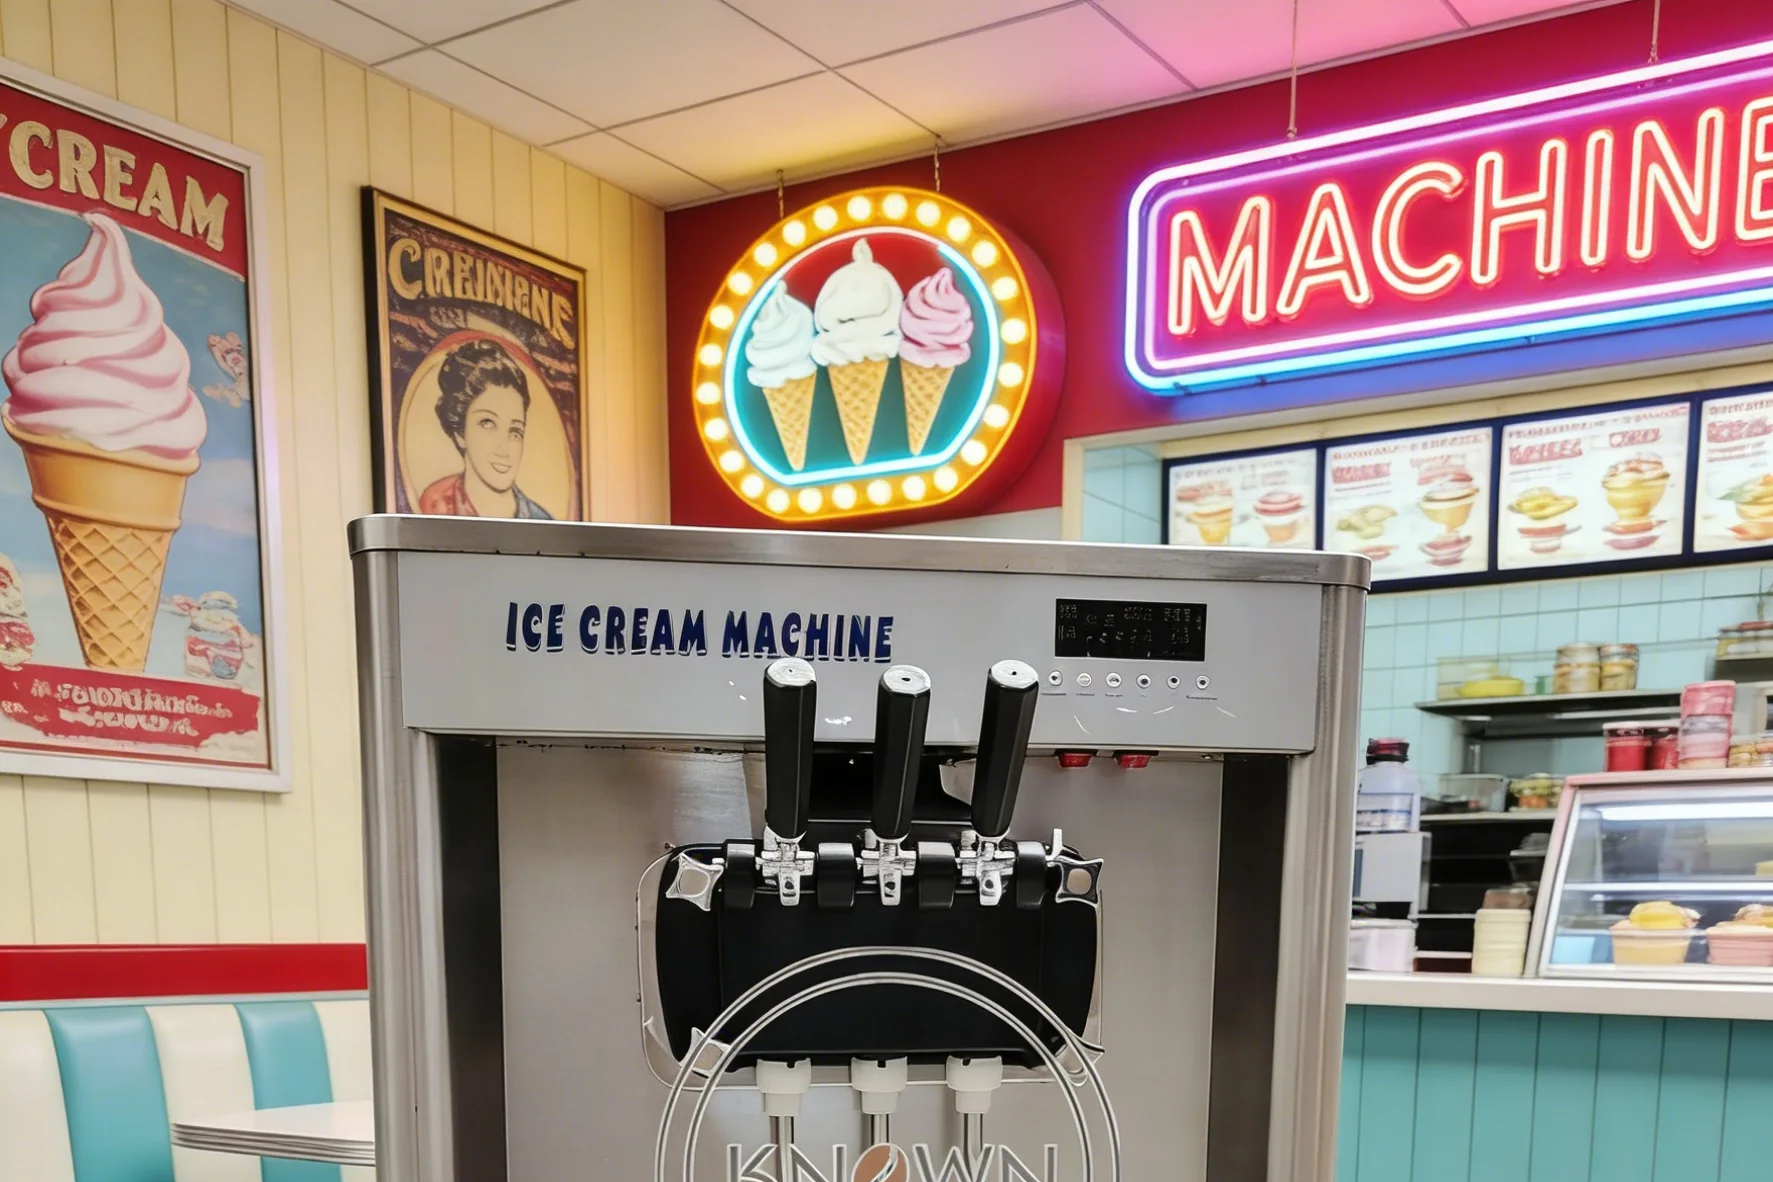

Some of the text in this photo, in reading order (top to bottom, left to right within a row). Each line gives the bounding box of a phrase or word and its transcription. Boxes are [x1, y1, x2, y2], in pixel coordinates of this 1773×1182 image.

[8, 120, 229, 252] CREAM
[506, 602, 894, 664] ICE CREAM MACHINE
